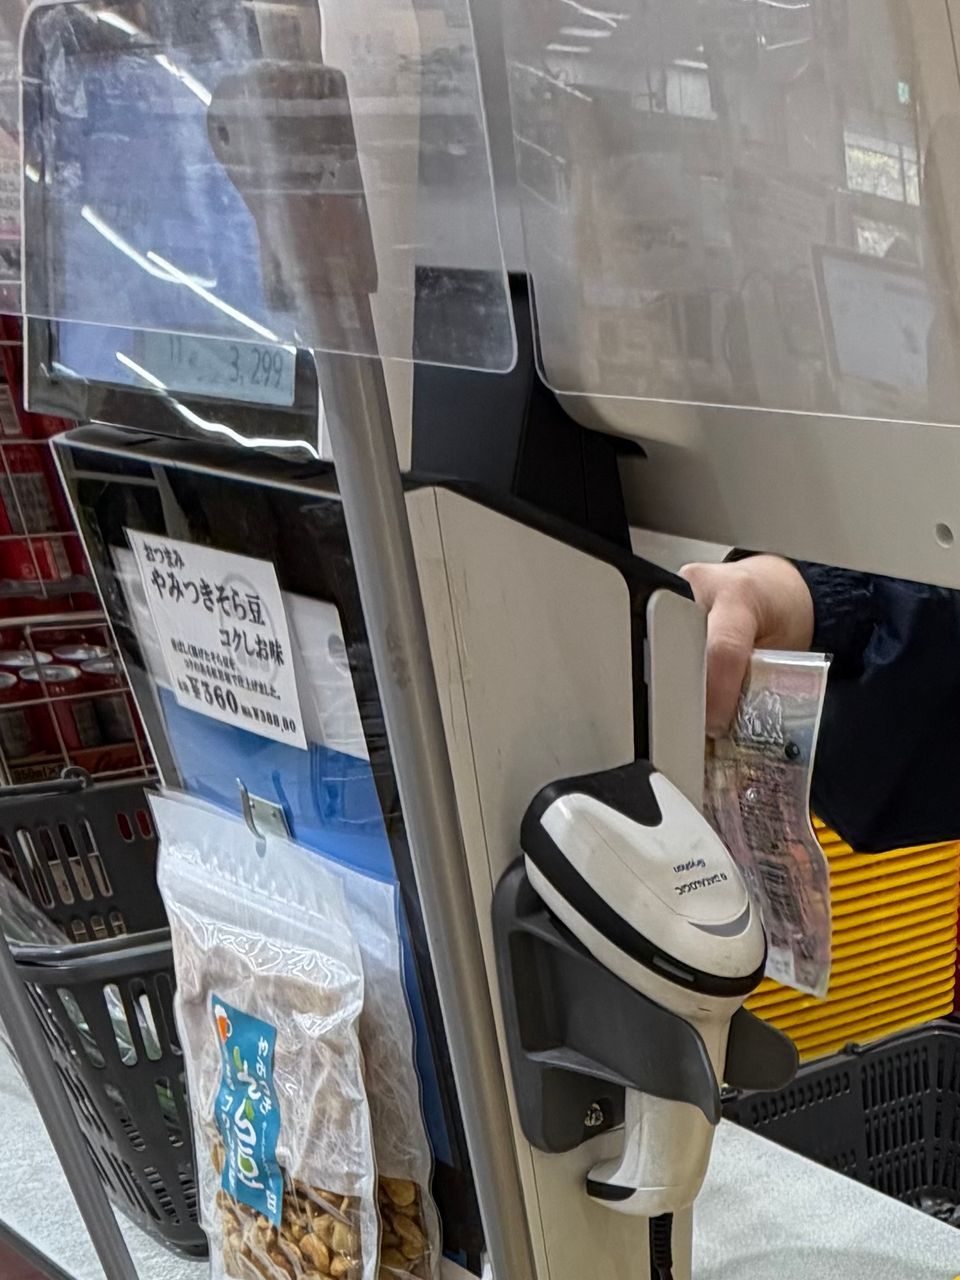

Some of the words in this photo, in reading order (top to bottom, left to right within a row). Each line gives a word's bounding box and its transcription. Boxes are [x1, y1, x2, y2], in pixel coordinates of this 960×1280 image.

[151, 568, 266, 626] やみつきそら豆
[219, 627, 285, 666] コクしお味
